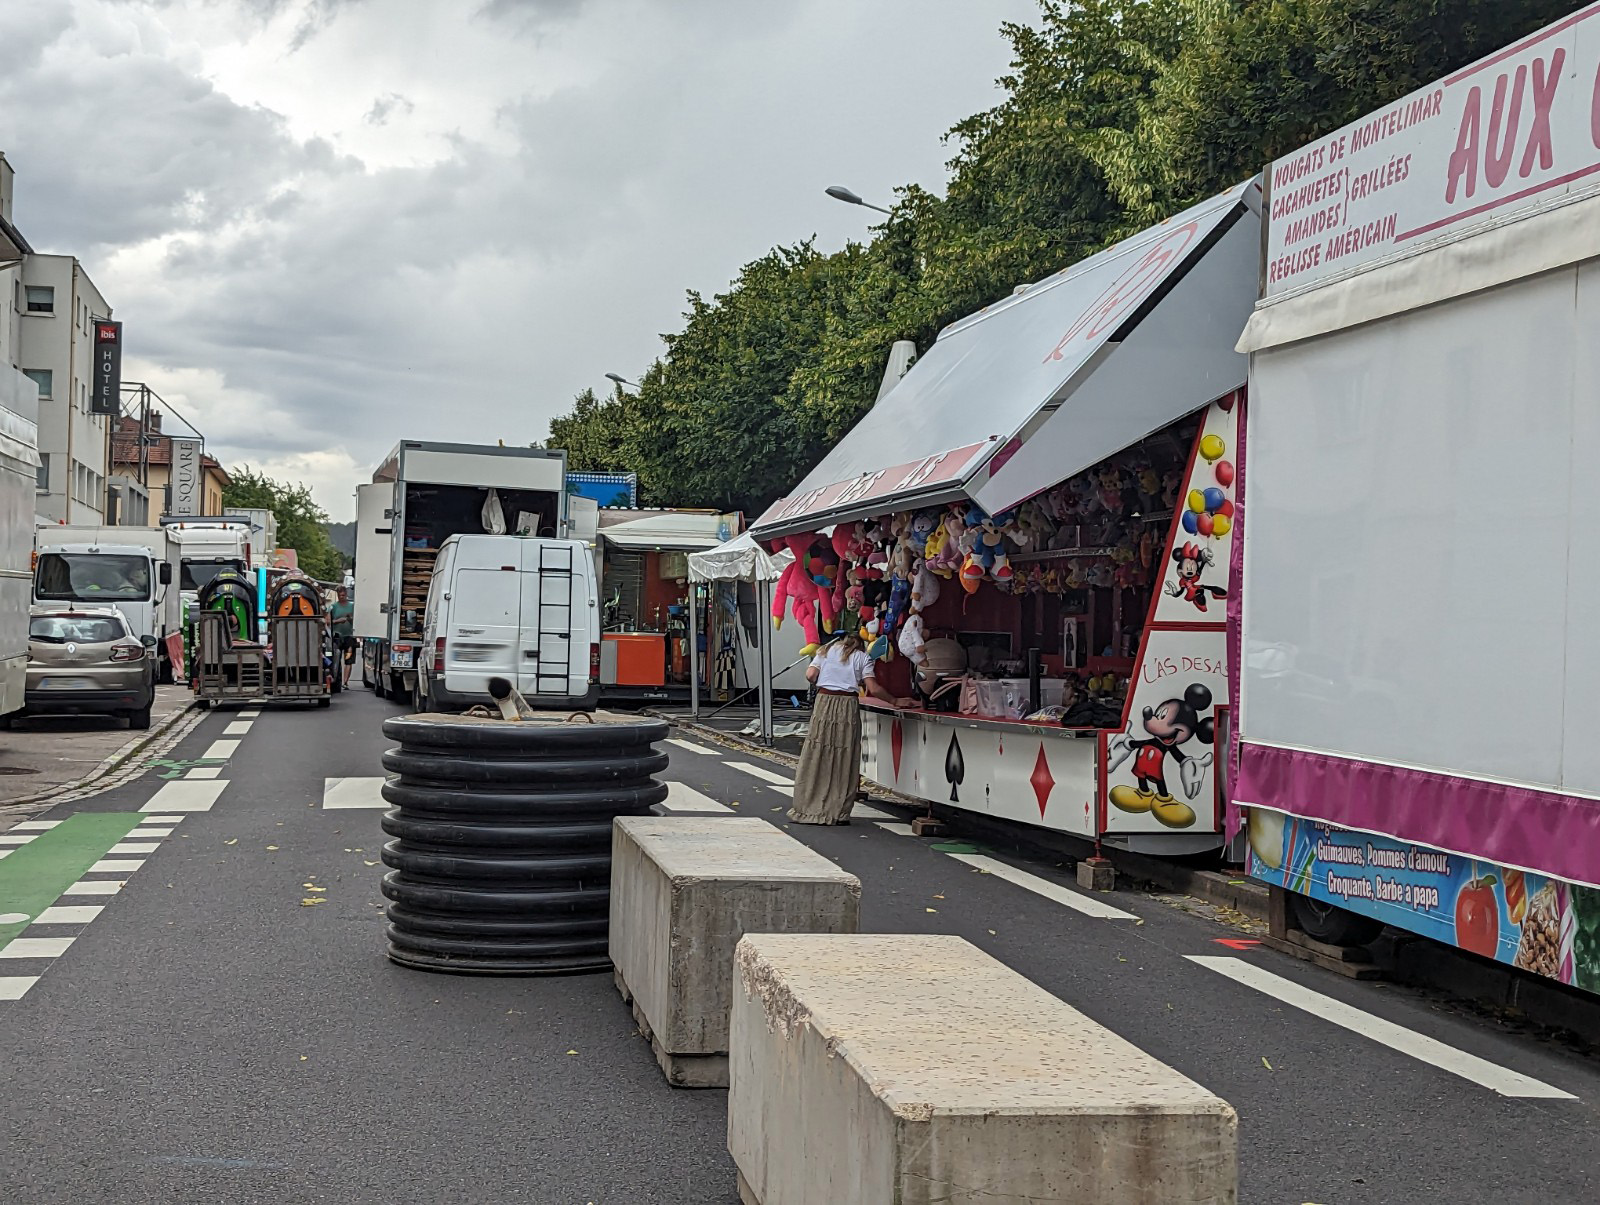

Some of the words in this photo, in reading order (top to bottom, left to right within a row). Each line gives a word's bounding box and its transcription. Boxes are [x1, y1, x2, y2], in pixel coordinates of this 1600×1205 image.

[1274, 145, 1326, 190] NOUGATS
[1329, 136, 1346, 164] DE
[1350, 89, 1443, 154] MONTELIMAR
[1446, 48, 1566, 204] AUX
[1272, 169, 1343, 221] CACAHUETES
[1351, 154, 1412, 201] GRILLÉES
[1269, 243, 1321, 283] RÉGLISSE
[1325, 213, 1397, 262] AMÉRICAIN
[1284, 202, 1341, 247] AMANDES
[101, 330, 115, 339] ibis
[103, 351, 112, 407] HOTEL
[178, 443, 196, 502] SQUARE
[828, 469, 886, 507] DES
[891, 451, 949, 492] AS
[1143, 658, 1178, 684] L'AS
[1317, 839, 1365, 868] Guimauves,
[1367, 842, 1406, 868] Pommes
[1408, 846, 1451, 876] d'amour,
[1327, 870, 1375, 900] Croquante,
[1375, 875, 1403, 901] Barbe
[1413, 885, 1439, 911] papa
